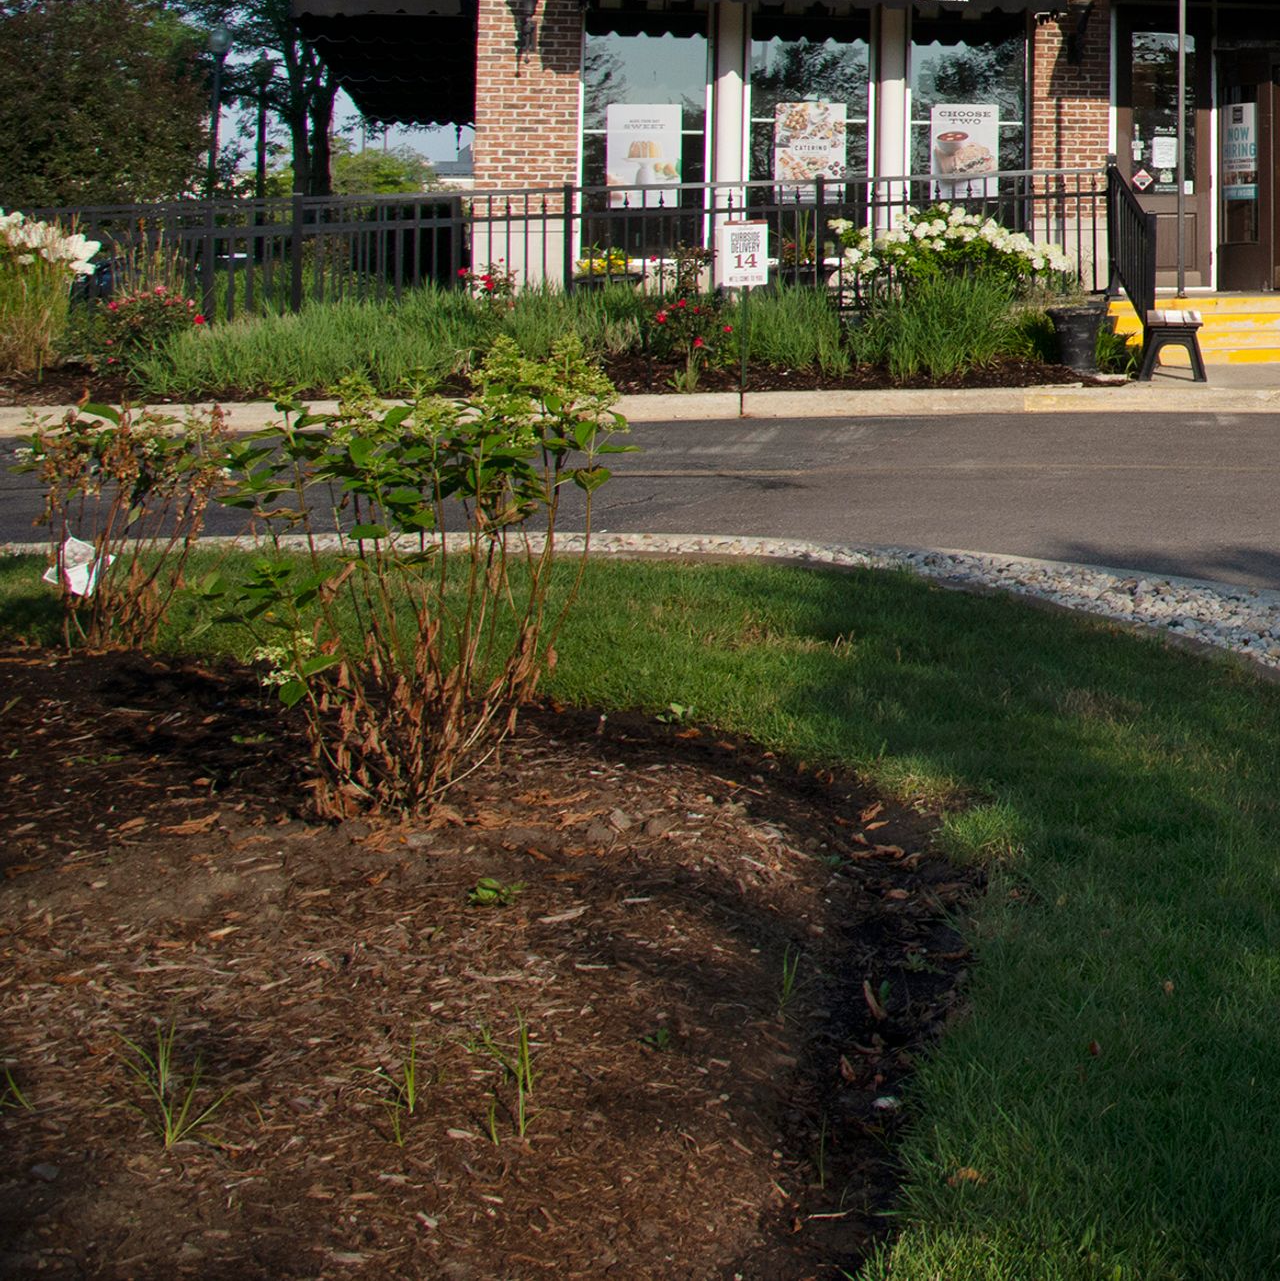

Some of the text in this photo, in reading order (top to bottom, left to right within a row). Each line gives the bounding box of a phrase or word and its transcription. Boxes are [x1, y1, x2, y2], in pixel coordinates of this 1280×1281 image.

[939, 110, 992, 118] CHOOSE
[1228, 127, 1250, 141] NOW
[1224, 143, 1257, 158] HIRING
[730, 231, 761, 243] CURBSIDE
[730, 242, 761, 254] DELIVERY
[734, 253, 758, 269] 14
